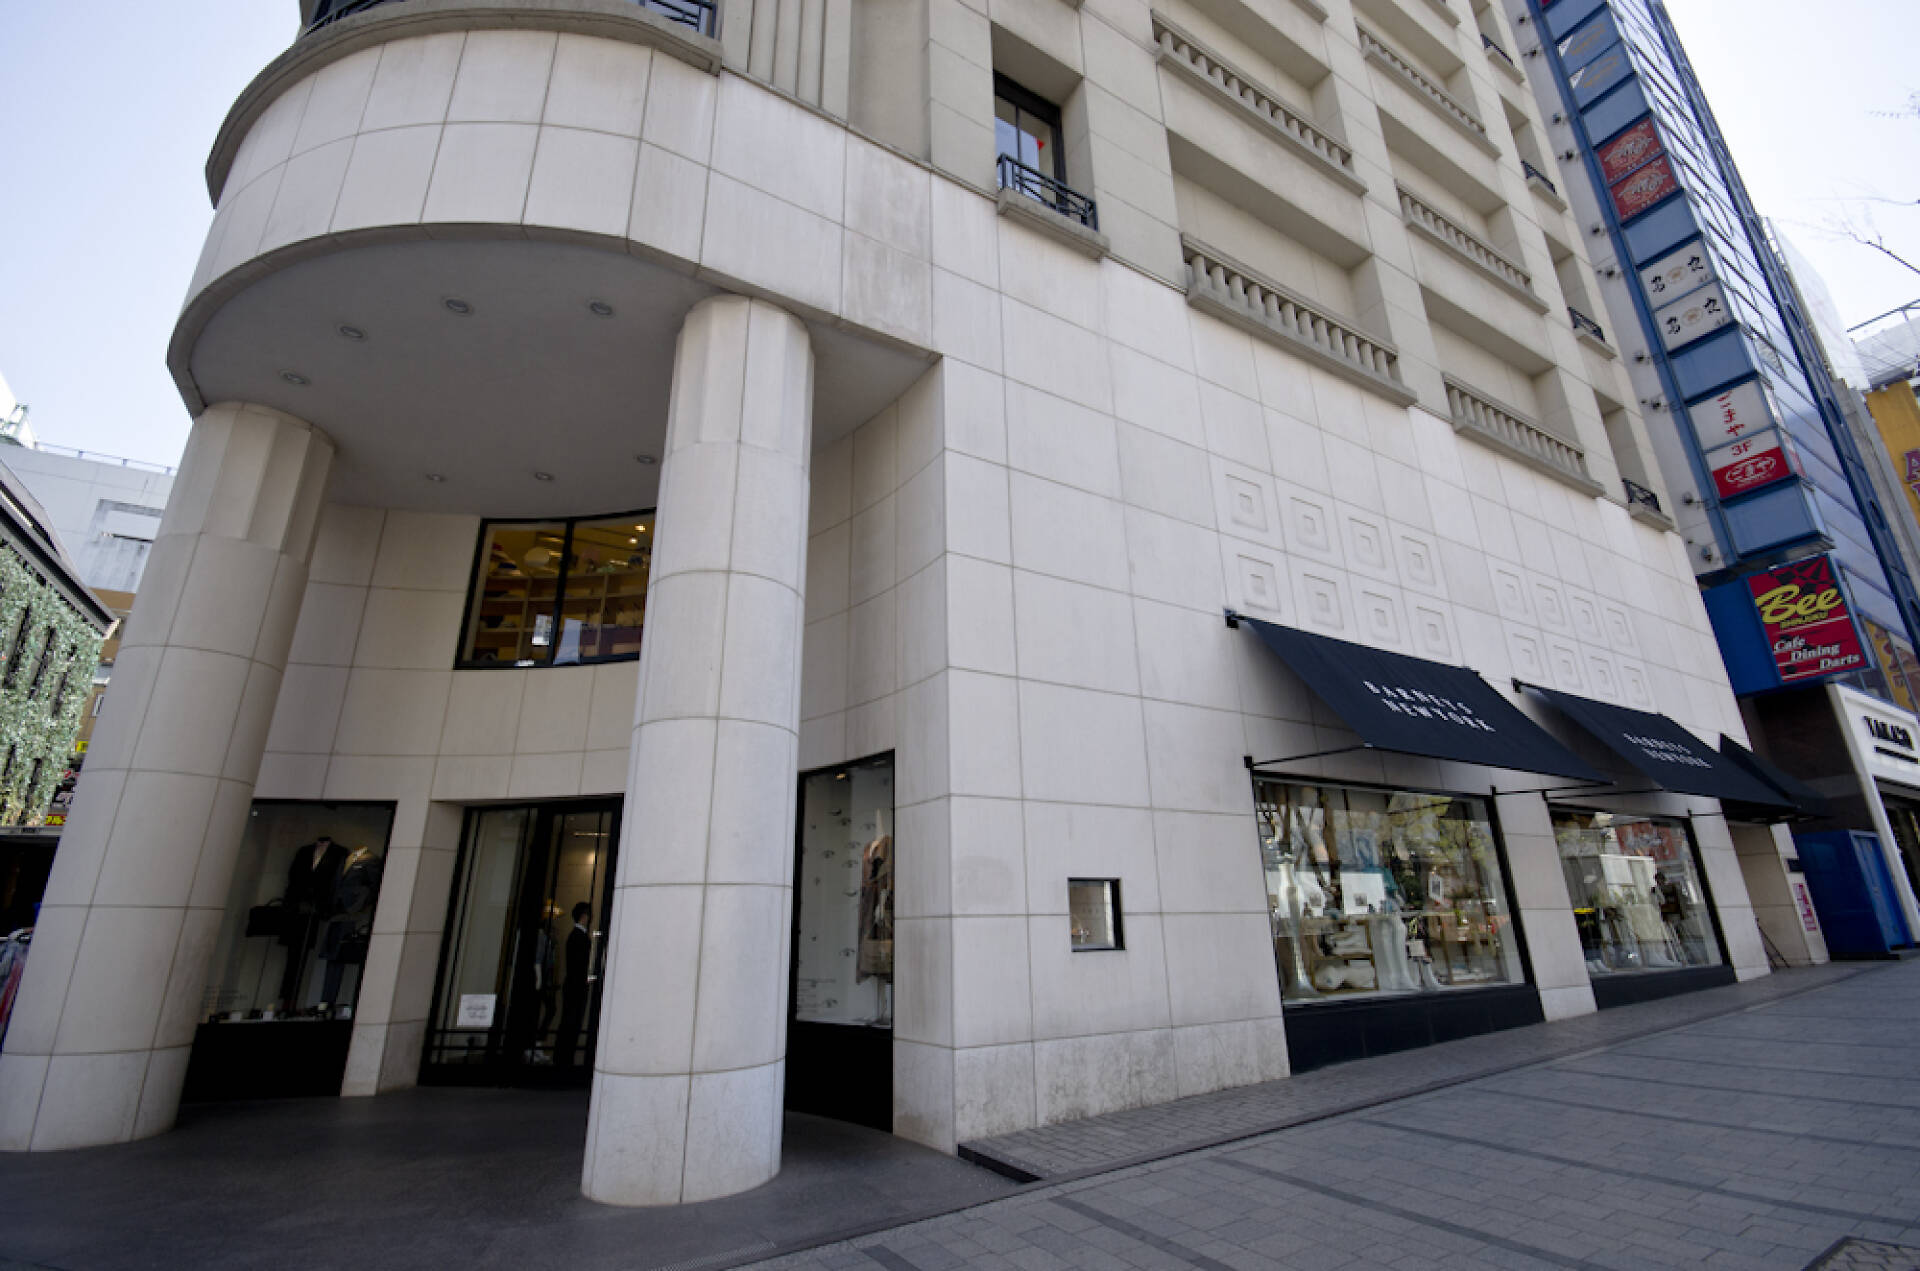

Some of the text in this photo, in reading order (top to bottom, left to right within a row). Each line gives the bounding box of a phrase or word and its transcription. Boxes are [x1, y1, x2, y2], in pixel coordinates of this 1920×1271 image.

[1731, 439, 1753, 456] 3F
[1755, 584, 1842, 624] Bee
[1790, 644, 1840, 662] Dining
[1820, 654, 1860, 670] Darts
